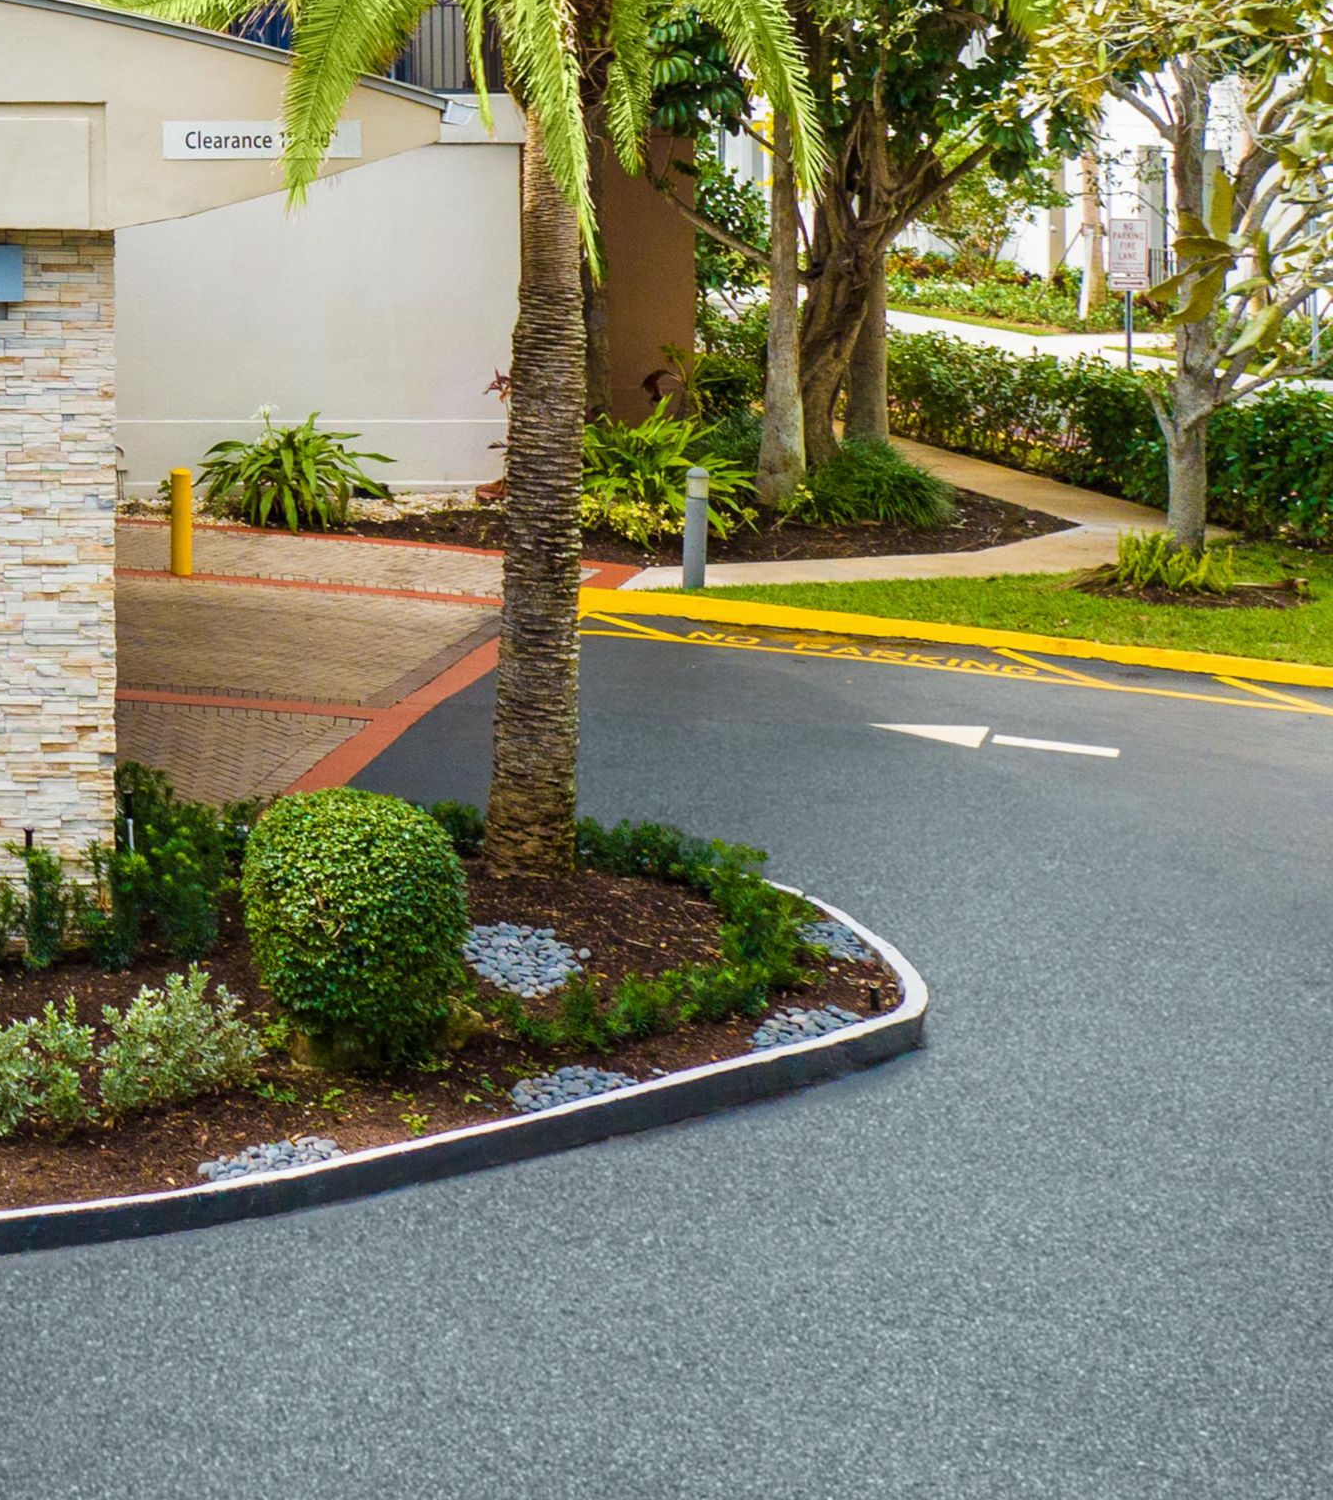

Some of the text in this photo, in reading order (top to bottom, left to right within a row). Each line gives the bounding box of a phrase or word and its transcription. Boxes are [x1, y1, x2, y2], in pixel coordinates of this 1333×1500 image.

[185, 130, 273, 150] Clearance
[687, 631, 1038, 675] NO PARKING
